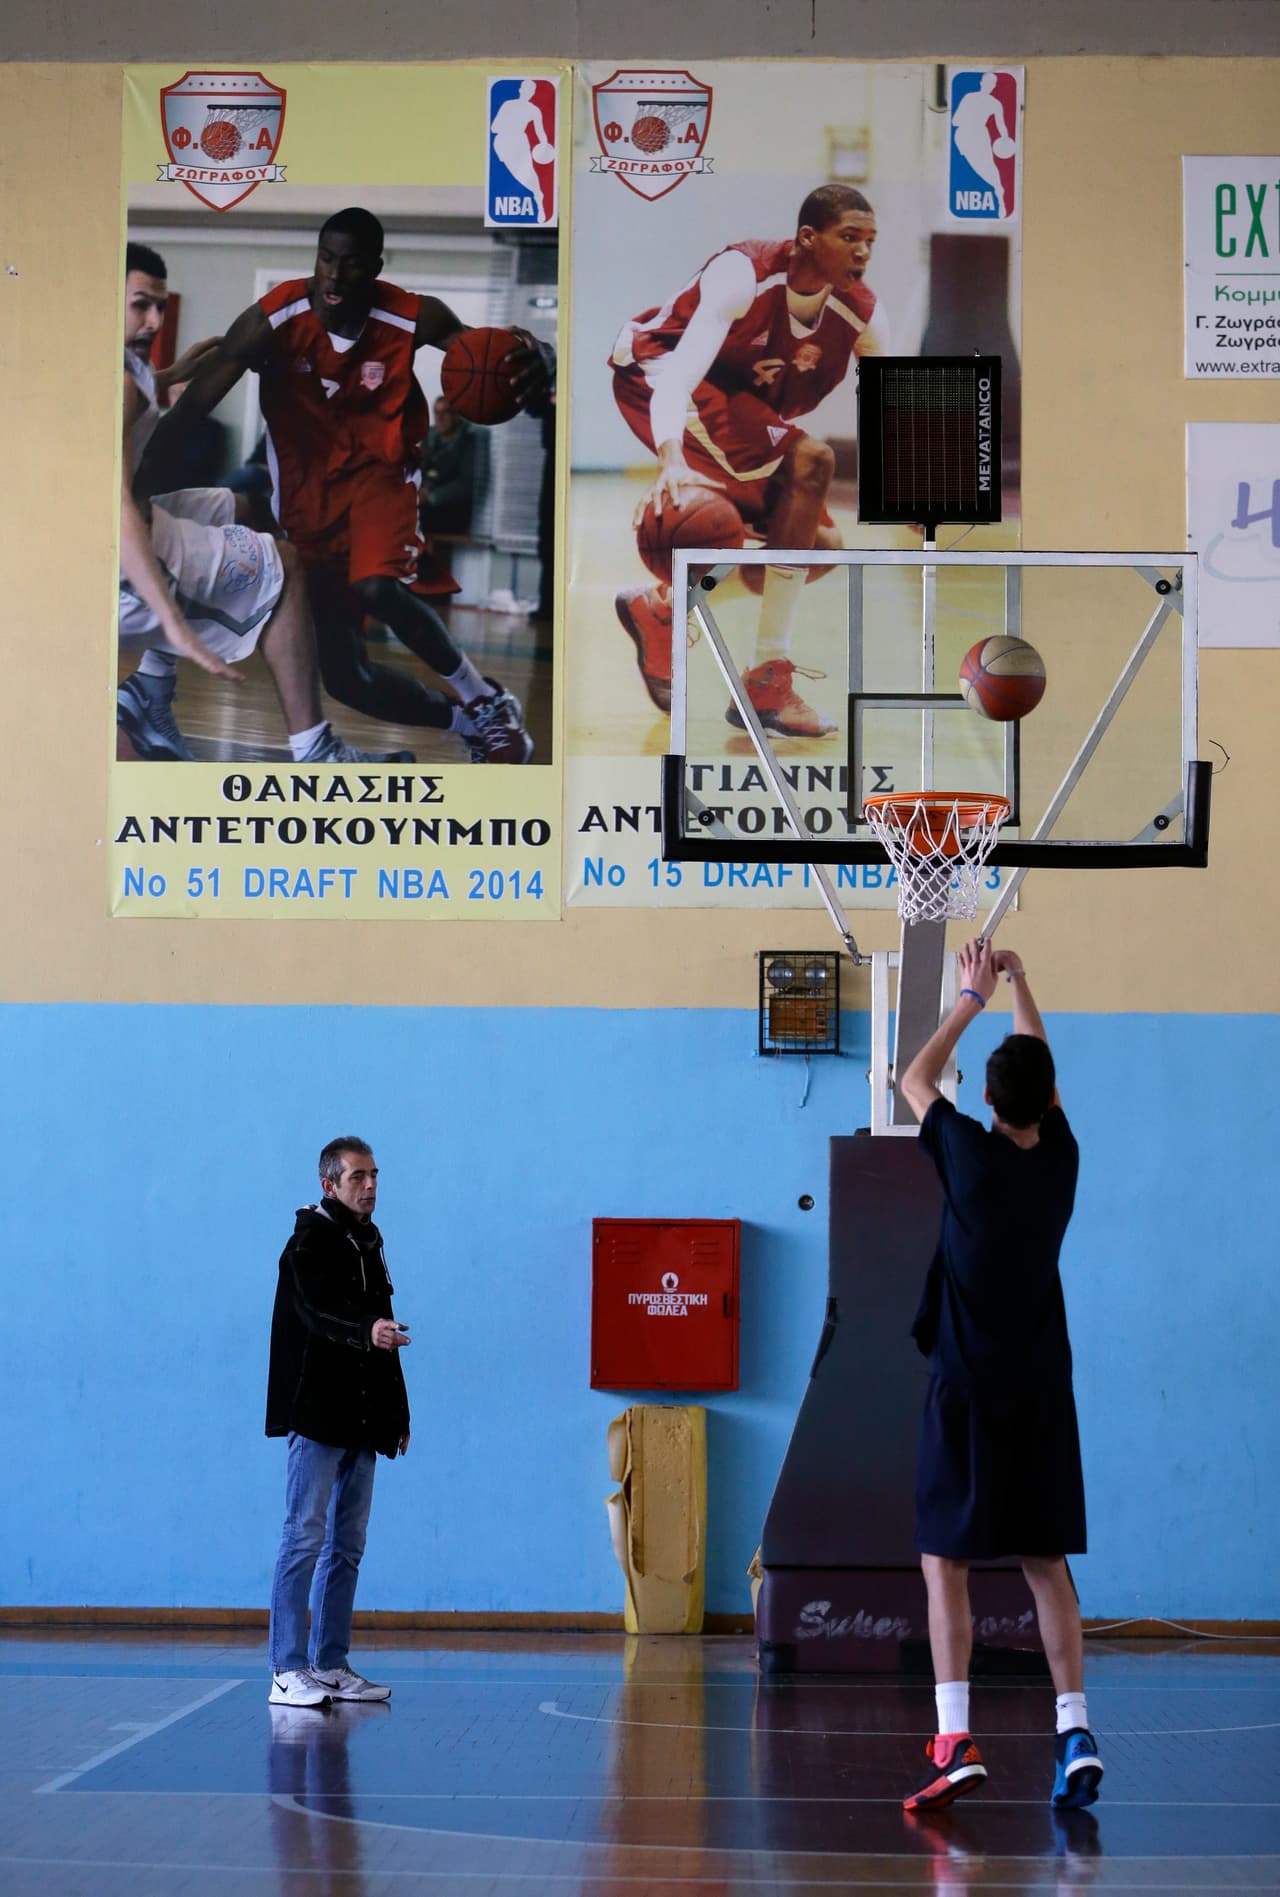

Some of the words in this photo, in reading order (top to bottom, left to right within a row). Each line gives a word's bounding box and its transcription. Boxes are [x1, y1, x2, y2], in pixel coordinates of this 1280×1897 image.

[174, 167, 268, 182] ΖΩΓΡΑΦΟΥ
[607, 159, 695, 173] ΖΩΓΡΑΦΟΥ
[495, 196, 535, 216] NBA
[955, 191, 996, 211] NBA
[1215, 285, 1280, 306] Κομμ
[1196, 315, 1209, 329] Γ.
[1215, 334, 1280, 350] Ζωγρά
[979, 378, 991, 491] MEVATANCO
[221, 774, 445, 803] ΘΑΝΑΣΗΣ
[114, 816, 551, 846] ΑΝΤΕΤΟΚΟΥΝΜΠΟ
[583, 857, 626, 887] No
[647, 858, 683, 888] 15
[124, 867, 167, 898] No
[187, 868, 220, 897] 51
[244, 868, 358, 899] DRAFT
[378, 869, 450, 899] NBA
[468, 870, 544, 900] 2014
[628, 1293, 708, 1305] ΠΥΡΟΣΒΕΣΤΙΚΗ
[647, 1304, 689, 1317] ΦΩΛΕΑ
